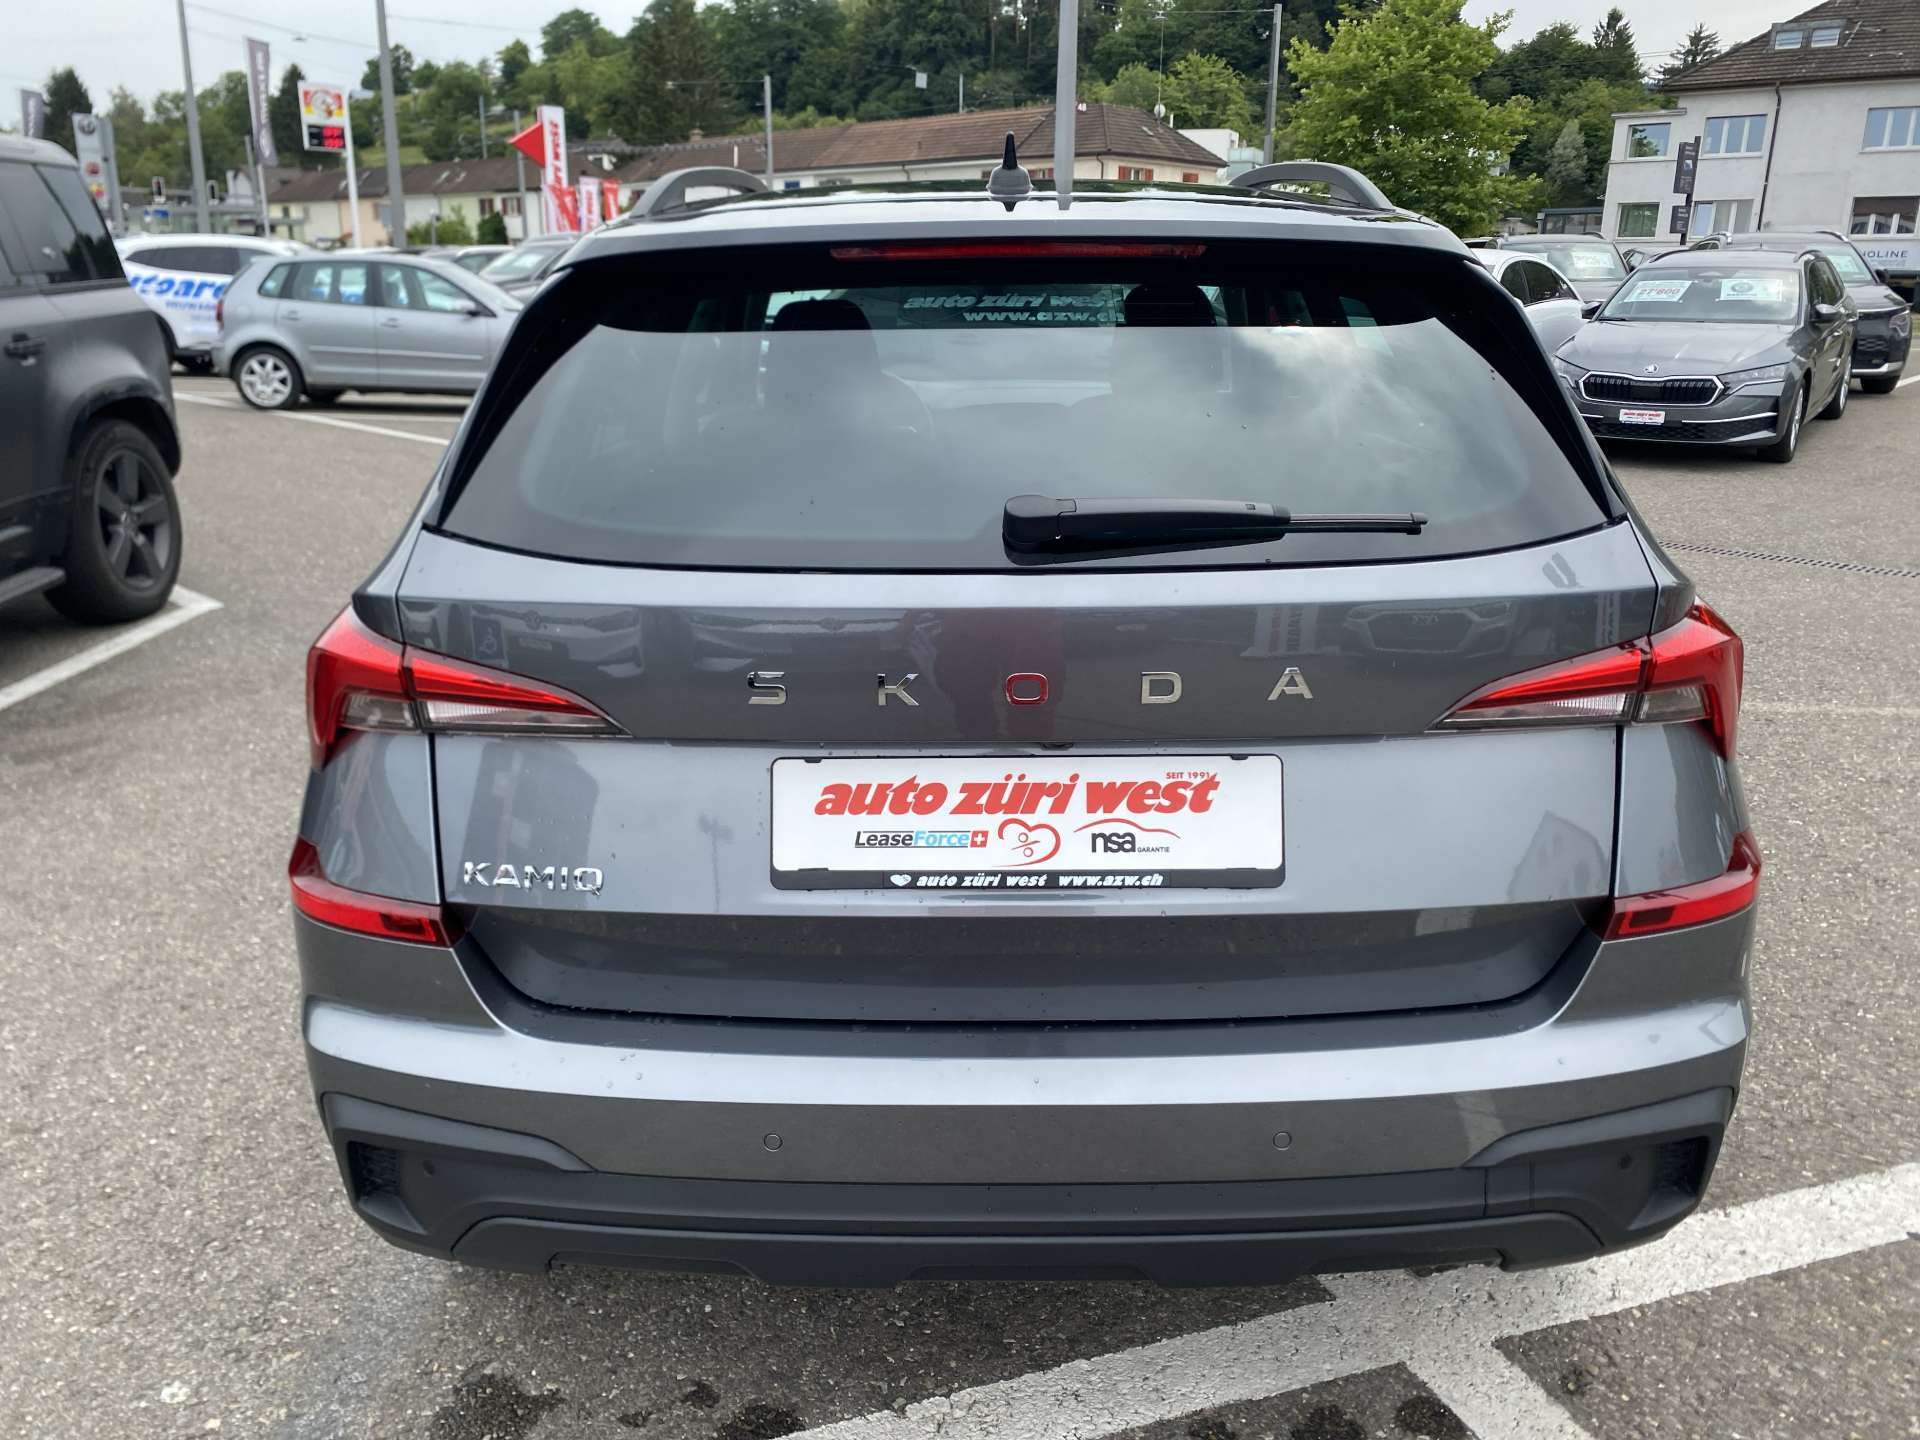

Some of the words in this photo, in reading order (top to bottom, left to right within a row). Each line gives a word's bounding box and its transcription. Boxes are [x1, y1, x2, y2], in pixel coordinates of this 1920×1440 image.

[903, 294, 977, 309] auto
[976, 293, 1047, 308] züri
[962, 310, 1126, 322] www.azw.ch
[1166, 772, 1184, 780] SEIT
[1187, 771, 1211, 780] 1991
[814, 775, 949, 816] auto
[949, 773, 1080, 815] züri
[1086, 773, 1221, 814] west
[855, 830, 970, 847] LeaseForce
[1091, 832, 1136, 853] nsa
[463, 861, 605, 896] KAMIQ
[916, 873, 958, 887] auto
[961, 872, 1002, 887] züri
[1006, 873, 1048, 887] west
[1058, 873, 1164, 887] www.azw.ch
